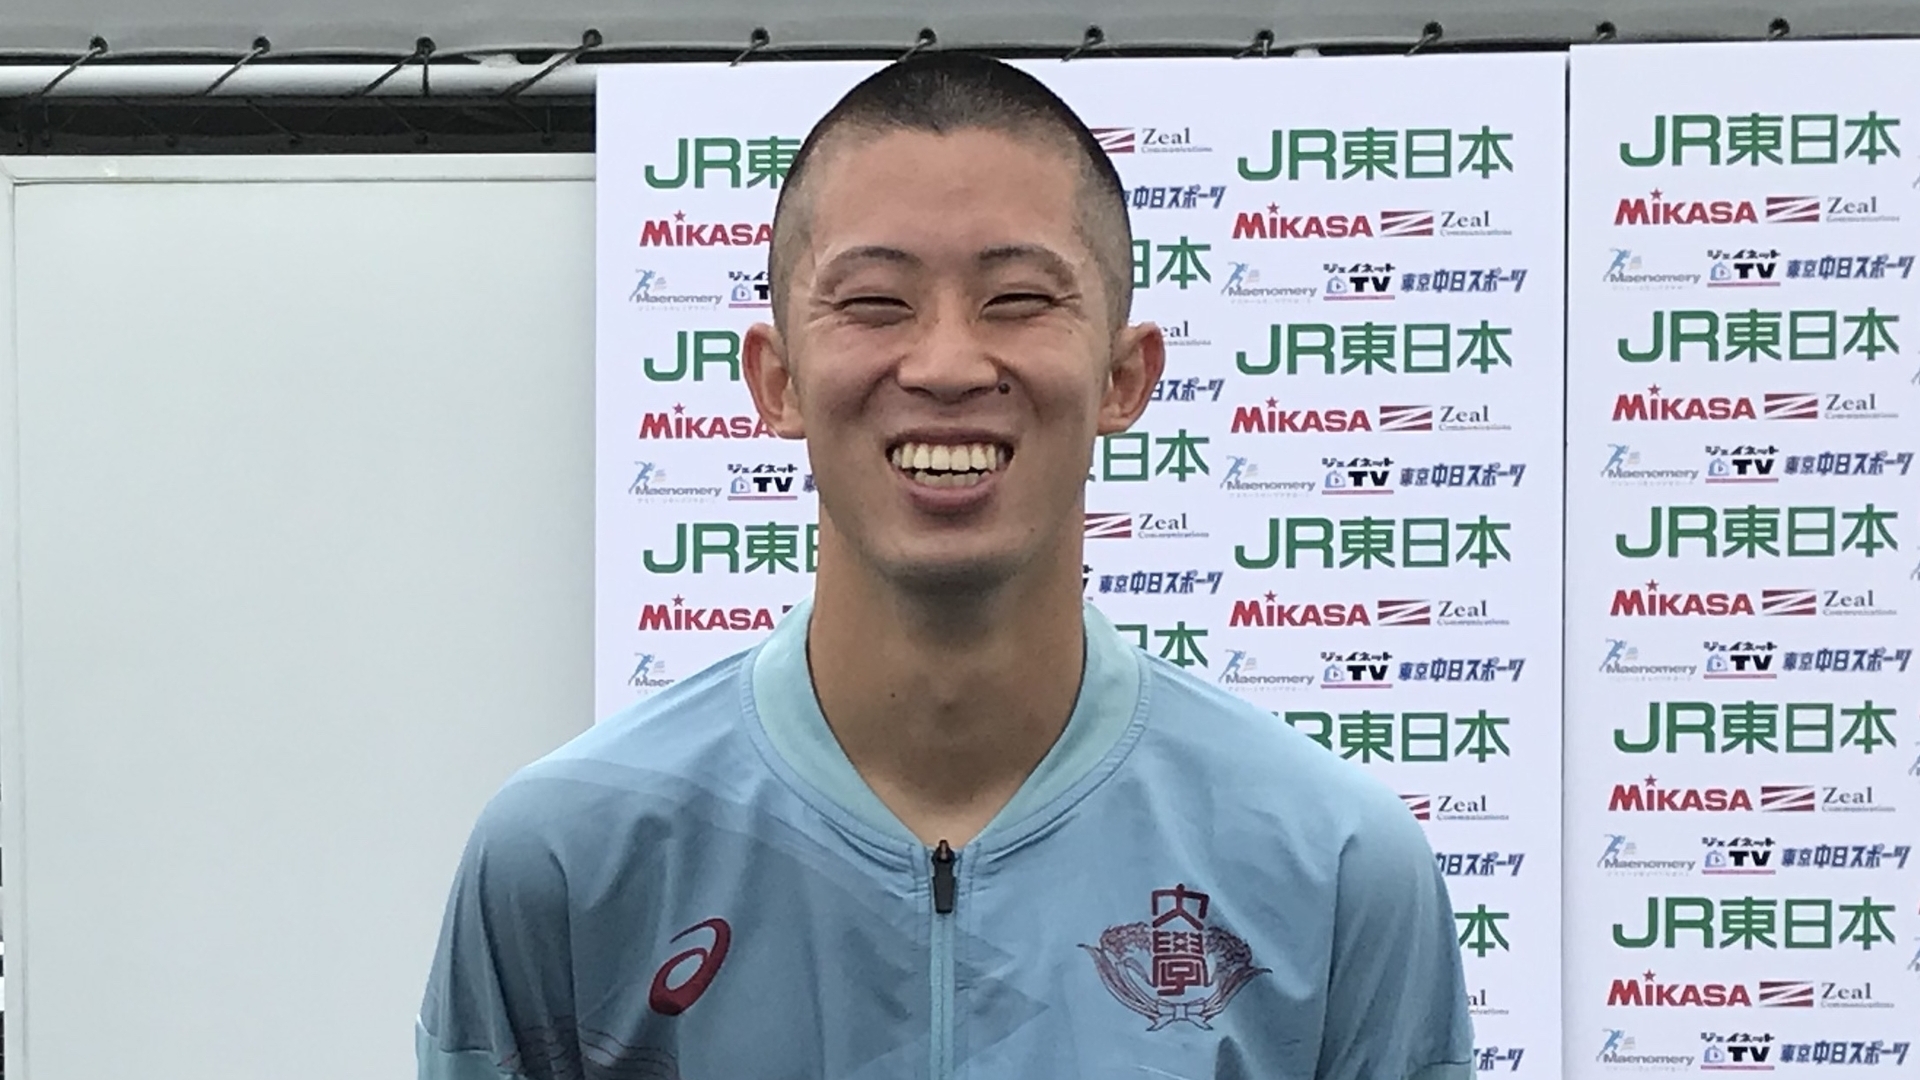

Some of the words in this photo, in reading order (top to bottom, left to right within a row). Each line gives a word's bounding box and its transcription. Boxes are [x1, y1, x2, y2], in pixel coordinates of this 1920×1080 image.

[1141, 128, 1191, 146] Zeal
[1620, 110, 1901, 167] JR東日本
[1237, 125, 1513, 181] JR東日本
[1827, 196, 1876, 214] Zeal
[1441, 210, 1489, 228] Zeal
[1733, 262, 1777, 279] TV
[1786, 254, 1915, 280] 東京中日スポーツ
[1349, 276, 1392, 292] TV
[1401, 267, 1528, 293] 東京中日スポーツ
[1618, 307, 1900, 363] JR東日本
[643, 330, 741, 382] JR
[1236, 320, 1512, 375] JR東日本
[1826, 393, 1875, 411] Zeal
[1440, 405, 1489, 423] Zeal
[1089, 429, 1210, 482] 日本
[1784, 451, 1914, 476] 東京中日スポーツ
[1399, 462, 1526, 488] 東京中日スポーツ
[1731, 459, 1775, 475] TV
[753, 477, 793, 492] TV
[1347, 471, 1390, 487] TV
[1139, 512, 1188, 530] Zeal
[1616, 503, 1898, 559] JR東日本
[1234, 514, 1511, 570] JR東日本
[1099, 569, 1223, 595] 東京中日スポーツ
[1438, 600, 1487, 617] Zeal
[1824, 590, 1873, 607] Zeal
[1398, 657, 1526, 682] 東京中日スポーツ
[1730, 654, 1773, 671] TV
[1782, 647, 1912, 672] 東京中日スポーツ
[1346, 665, 1389, 681] TV
[1271, 709, 1510, 763] R東日本
[1614, 700, 1897, 754] JR東日本
[1438, 795, 1487, 812] Zeal
[1823, 786, 1872, 804] Zeal
[1728, 850, 1772, 867] TV
[1781, 843, 1911, 869] 東京中日スポーツ
[1612, 896, 1896, 951] JR東日本
[1822, 982, 1871, 1000] Zeal
[1726, 1046, 1770, 1063] TV
[1780, 1040, 1910, 1066] 東京中日スポーツ
